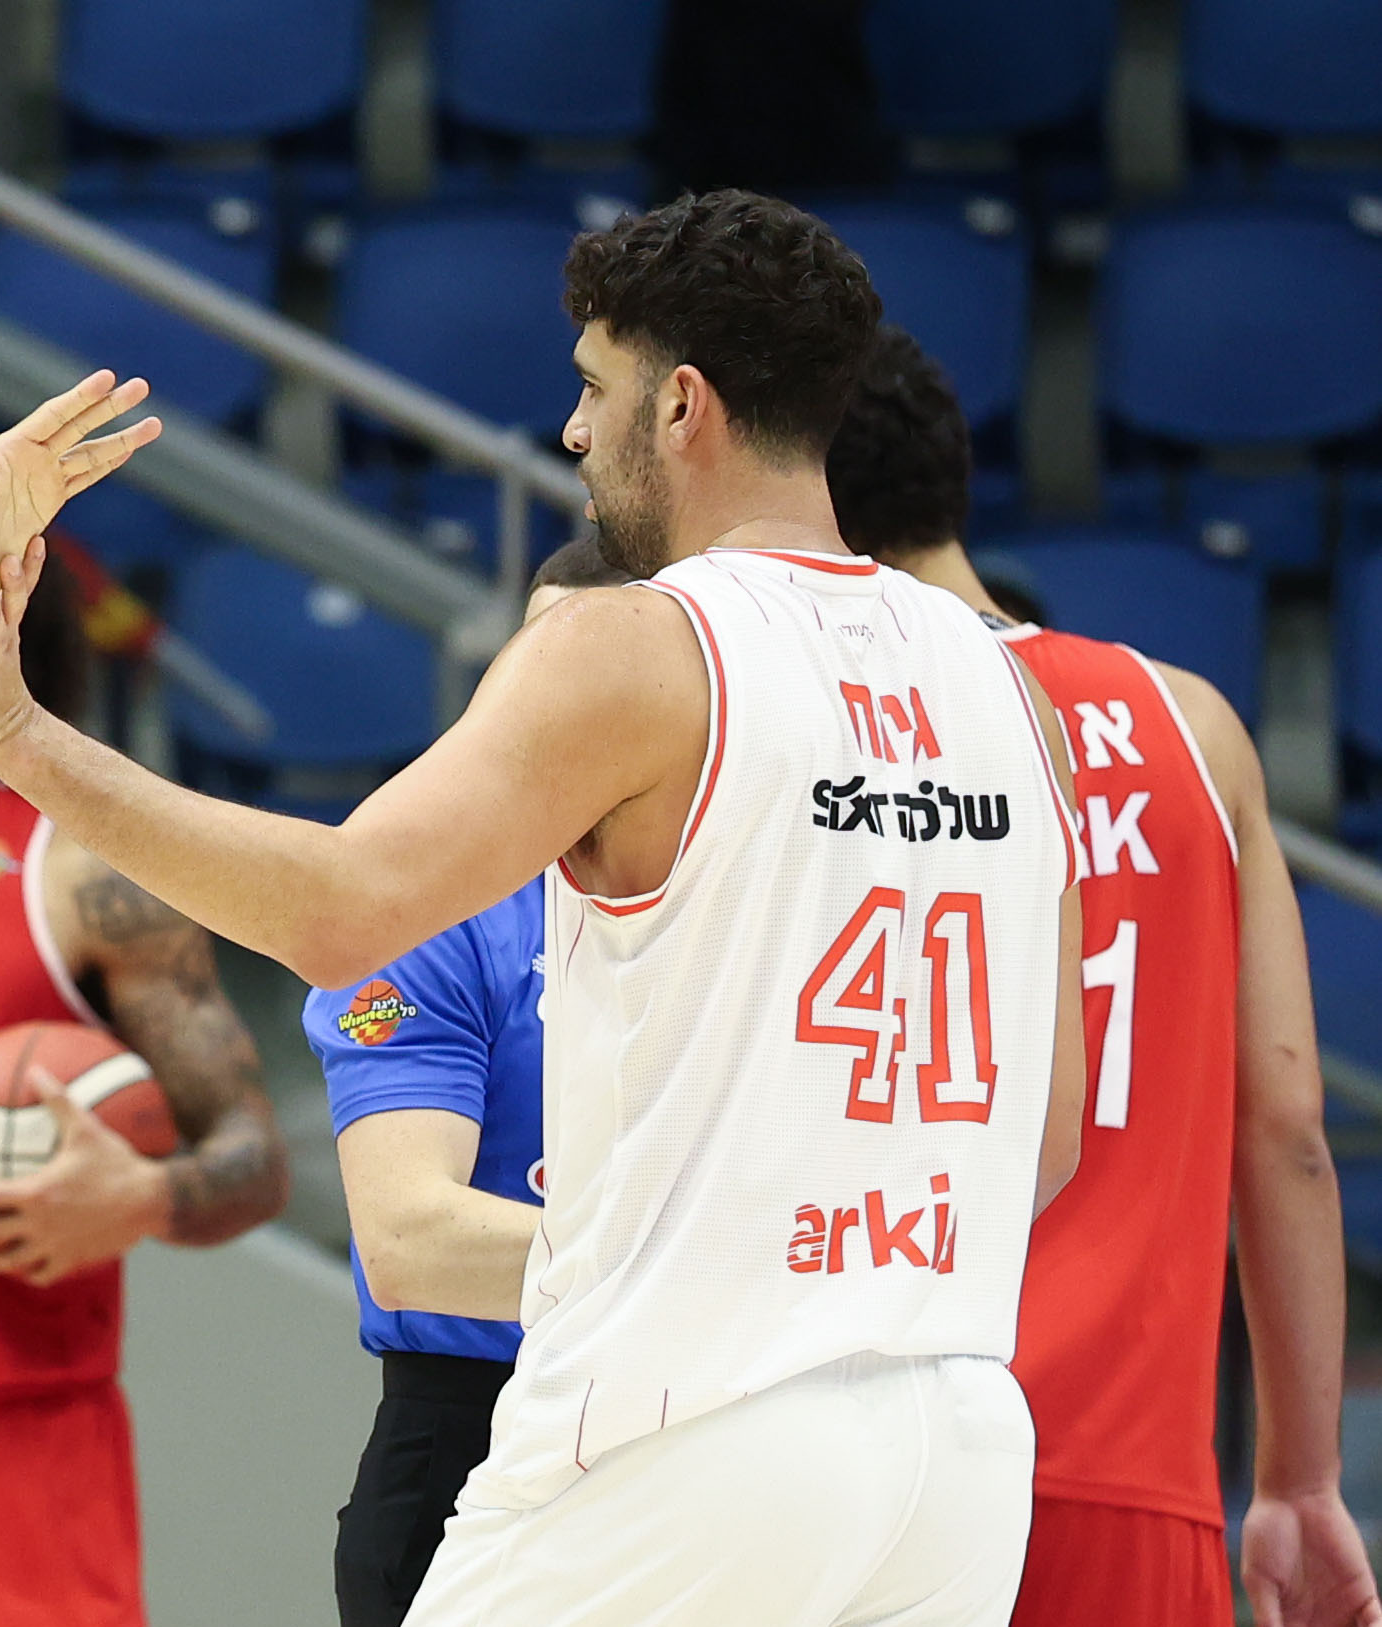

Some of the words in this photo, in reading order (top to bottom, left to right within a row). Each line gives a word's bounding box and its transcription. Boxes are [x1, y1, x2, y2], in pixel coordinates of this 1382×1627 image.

[338, 1008, 398, 1032] Winner
[795, 886, 998, 1126] 41
[787, 1172, 958, 1275] arki
